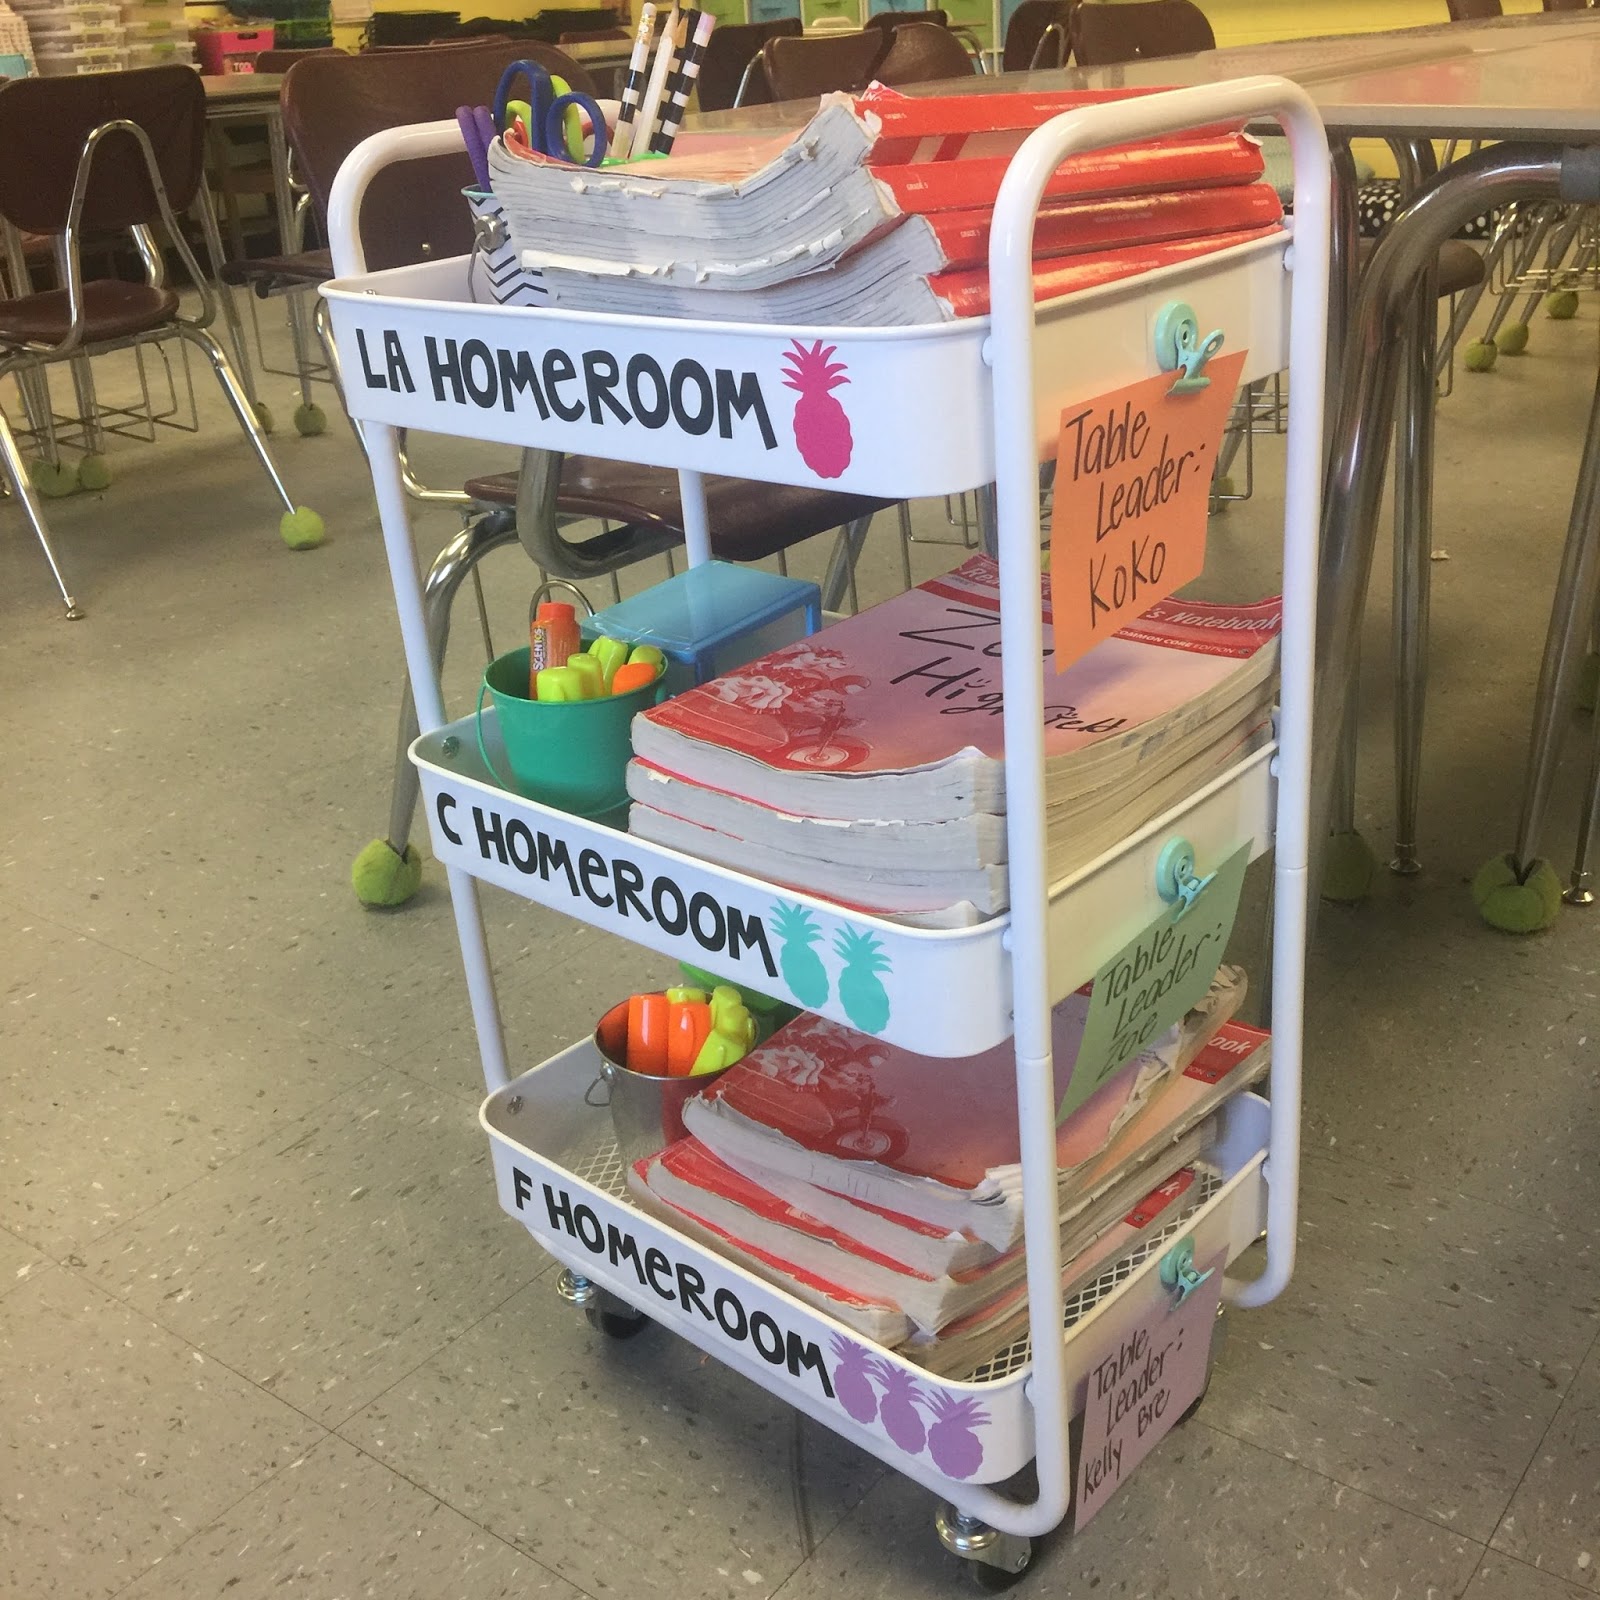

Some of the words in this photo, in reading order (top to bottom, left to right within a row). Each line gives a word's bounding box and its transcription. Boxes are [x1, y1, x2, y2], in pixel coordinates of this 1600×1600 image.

[355, 328, 415, 394] LA
[1066, 401, 1151, 482] Table
[1096, 434, 1206, 543] Leader:
[533, 628, 545, 670] SCENTOS
[1118, 630, 1163, 643] OMMON
[1163, 638, 1192, 648] CORE
[1193, 644, 1234, 654] EDITION
[1166, 611, 1282, 631] Notebook
[436, 792, 462, 846] C
[1102, 927, 1176, 1007] Table
[1112, 923, 1222, 1041] Leader:
[512, 1166, 533, 1212] F
[1093, 1328, 1150, 1400] Table
[1106, 1328, 1184, 1437] Leader:
